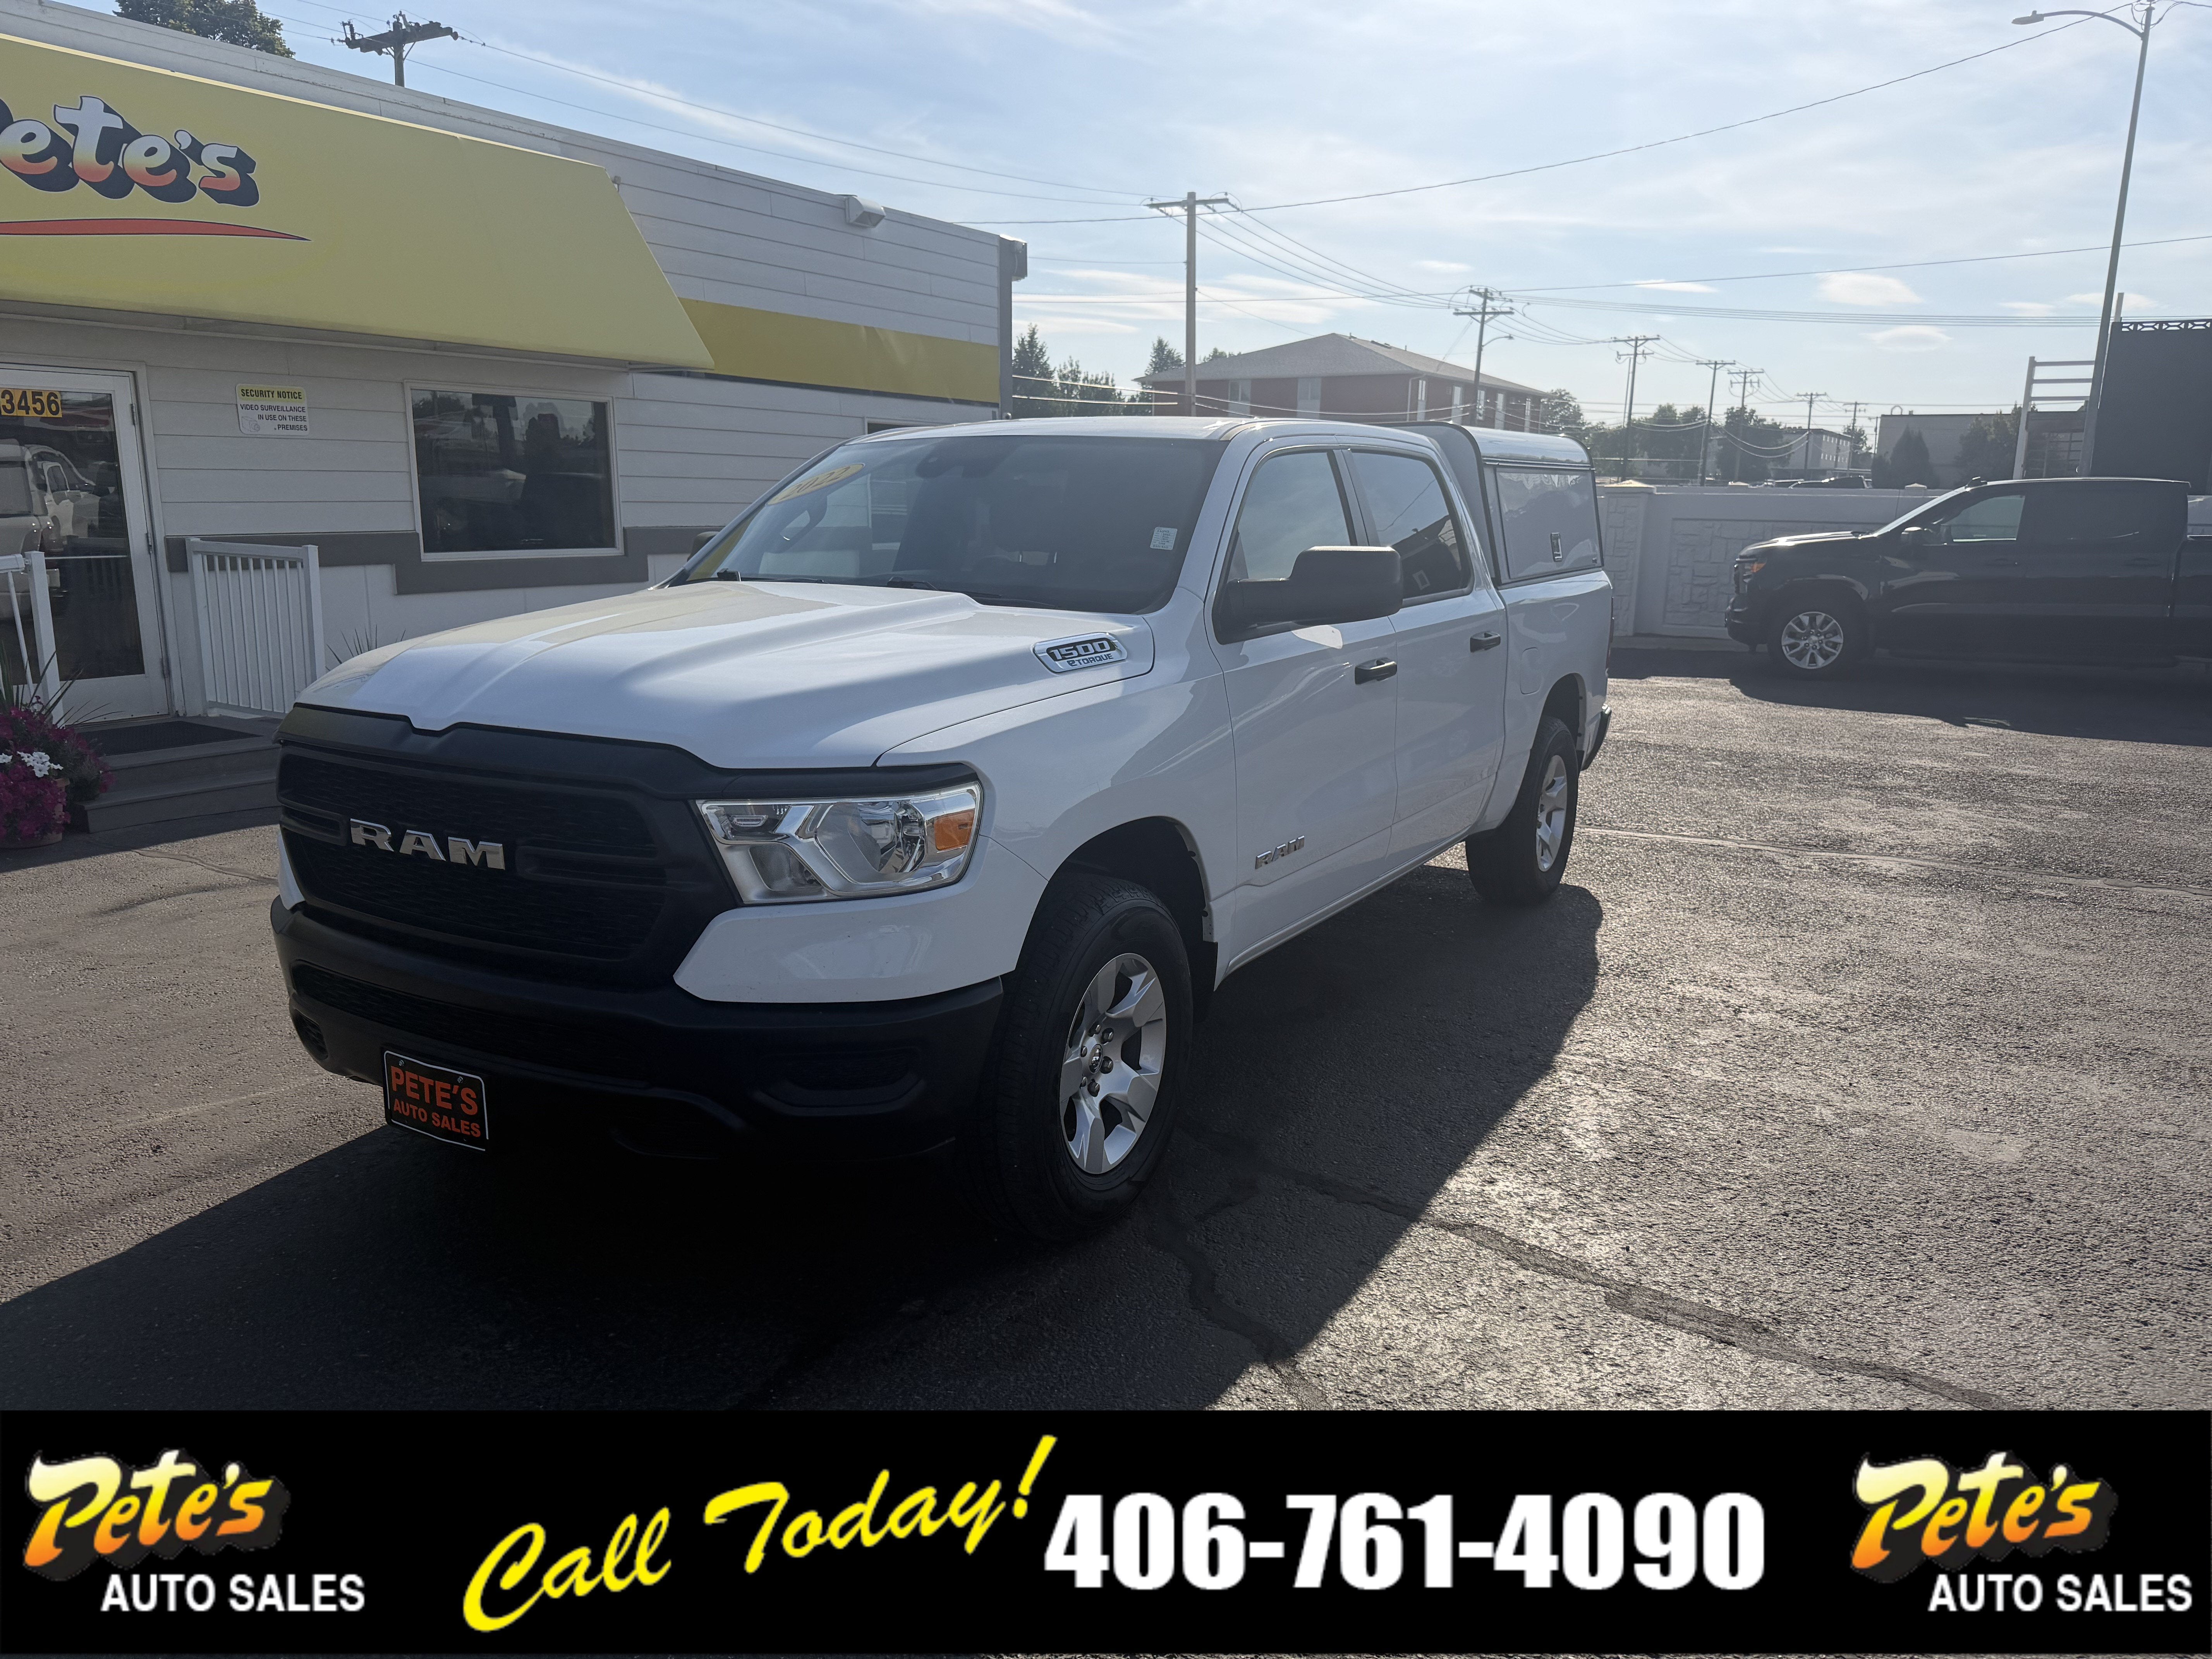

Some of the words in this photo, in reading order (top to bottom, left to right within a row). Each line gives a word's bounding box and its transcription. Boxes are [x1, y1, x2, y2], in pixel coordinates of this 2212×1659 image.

[0, 95, 260, 207] ete's
[1, 390, 60, 416] 3456
[241, 388, 275, 398] SECURITY
[277, 390, 302, 399] NOTICE
[260, 404, 306, 412] SURVEILLANCE
[778, 466, 851, 501] 2022
[1049, 640, 1111, 660] 1500
[350, 818, 505, 870] RAM
[1255, 835, 1305, 869] RAM
[391, 1065, 478, 1115] PETE'S
[393, 1099, 428, 1122] AUTO
[431, 1112, 481, 1137] SALES
